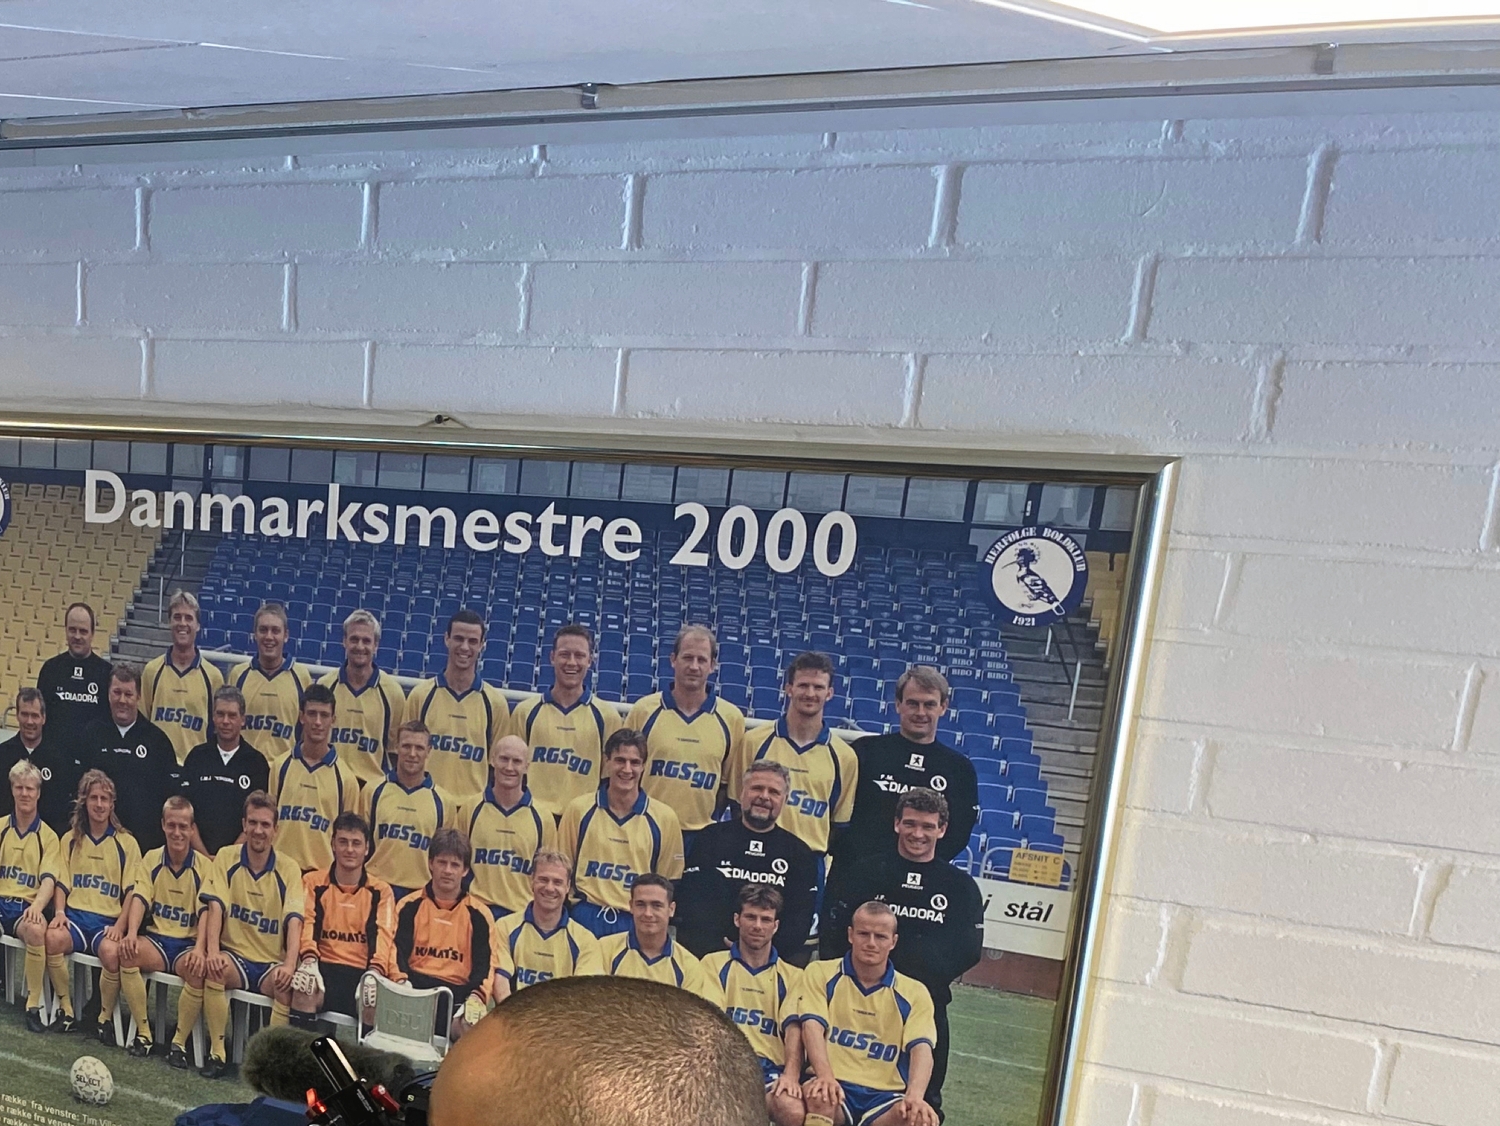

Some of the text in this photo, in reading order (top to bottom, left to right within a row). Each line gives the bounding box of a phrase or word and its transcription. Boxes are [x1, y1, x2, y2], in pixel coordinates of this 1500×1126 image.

[84, 469, 858, 577] Danmarksmestre 2000
[1042, 527, 1087, 572] BOLDKLUB
[1012, 615, 1036, 626] 1921
[532, 746, 593, 776] RGS90
[650, 759, 717, 790] RGS90
[1015, 852, 1060, 865] AFSNIT C
[585, 860, 640, 889] RGS9
[732, 867, 785, 887] DIADORA
[889, 904, 945, 924] DIADORA
[1004, 901, 1054, 923] stål
[321, 929, 367, 944] KOMATS
[2, 1093, 27, 1107] række
[31, 1100, 43, 1111] fra
[45, 1104, 80, 1121] venstre:
[82, 1114, 98, 1126] Tim
[6, 1105, 32, 1120] række
[33, 1112, 46, 1124] fra
